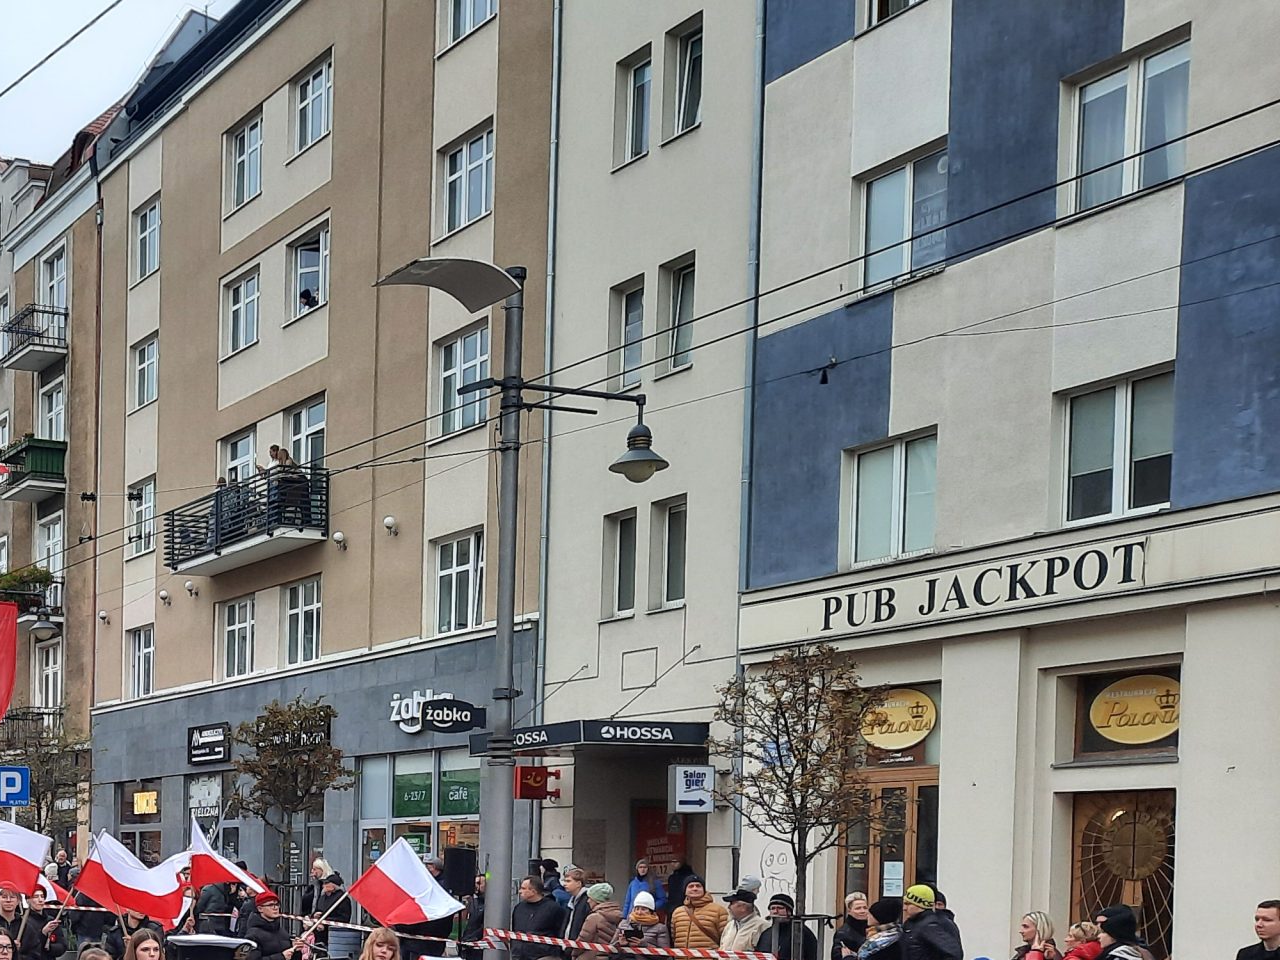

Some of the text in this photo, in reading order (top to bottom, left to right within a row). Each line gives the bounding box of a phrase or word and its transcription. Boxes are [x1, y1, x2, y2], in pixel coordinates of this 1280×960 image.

[820, 541, 1146, 631] PUB JACKPOT
[426, 706, 471, 721] żabka
[514, 730, 548, 746] OSSA
[616, 727, 674, 740] HOSSA
[683, 769, 706, 779] Salon
[0, 771, 22, 802] P
[685, 778, 705, 790] gier
[448, 786, 468, 801] café
